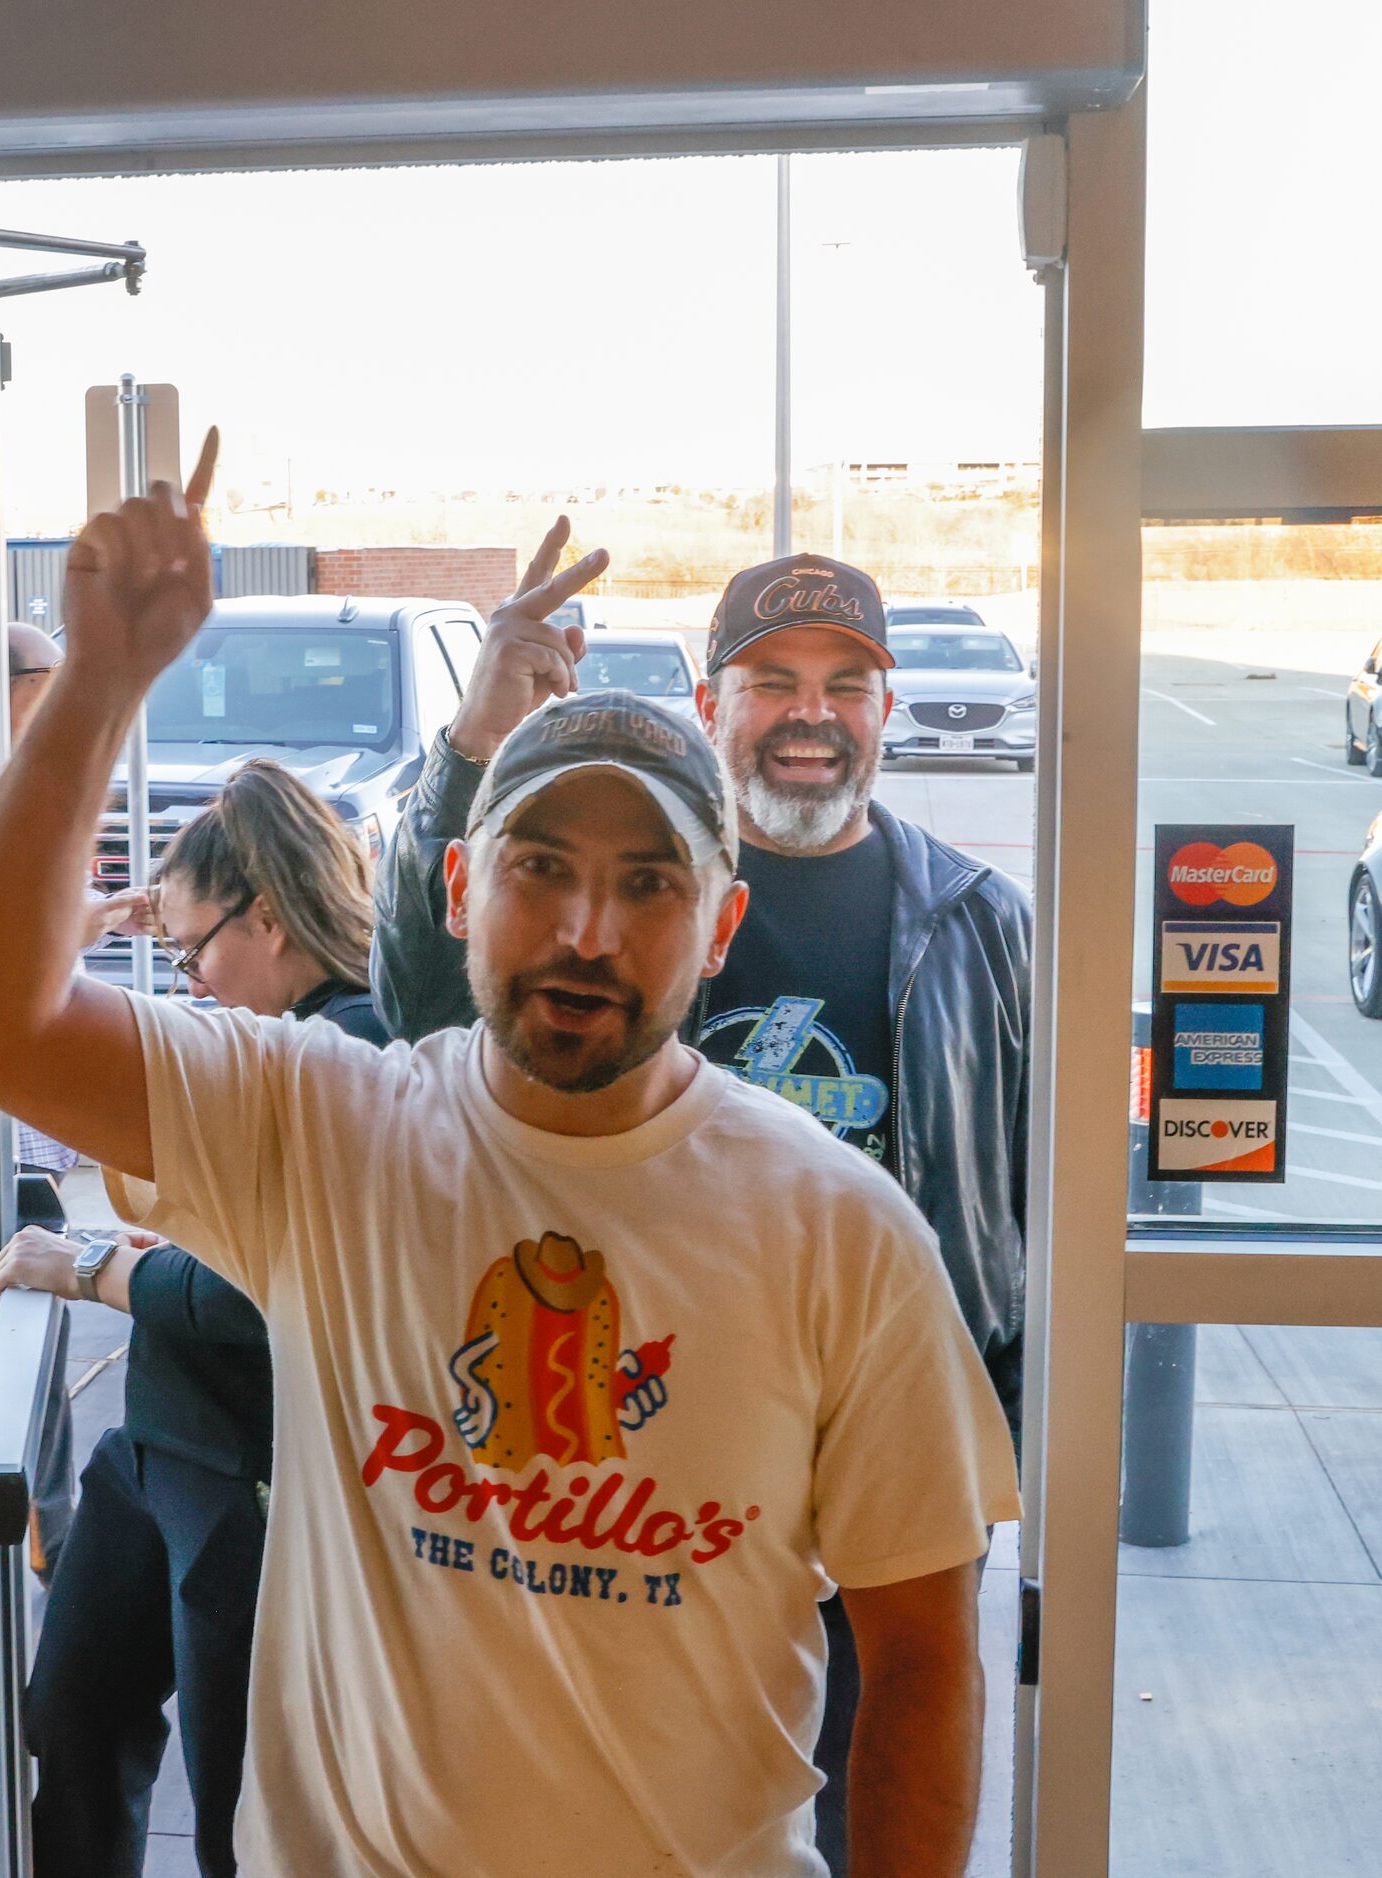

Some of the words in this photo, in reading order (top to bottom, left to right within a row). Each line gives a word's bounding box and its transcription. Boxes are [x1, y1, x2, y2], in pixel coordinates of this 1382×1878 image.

[791, 568, 835, 578] CHICAGO
[753, 575, 864, 621] Cubs
[540, 710, 615, 743] TRUCK
[629, 712, 687, 757] YARD
[1170, 865, 1275, 884] MasterCard
[1175, 942, 1265, 972] VISA
[1175, 1033, 1259, 1047] AMERICAN
[1192, 1050, 1264, 1064] EXPRESS
[1164, 1119, 1270, 1139] DISCOVER
[361, 1403, 745, 1565] Portillo's
[411, 1526, 475, 1572] THE
[490, 1547, 628, 1603] COLONY,
[644, 1573, 682, 1606] TX
